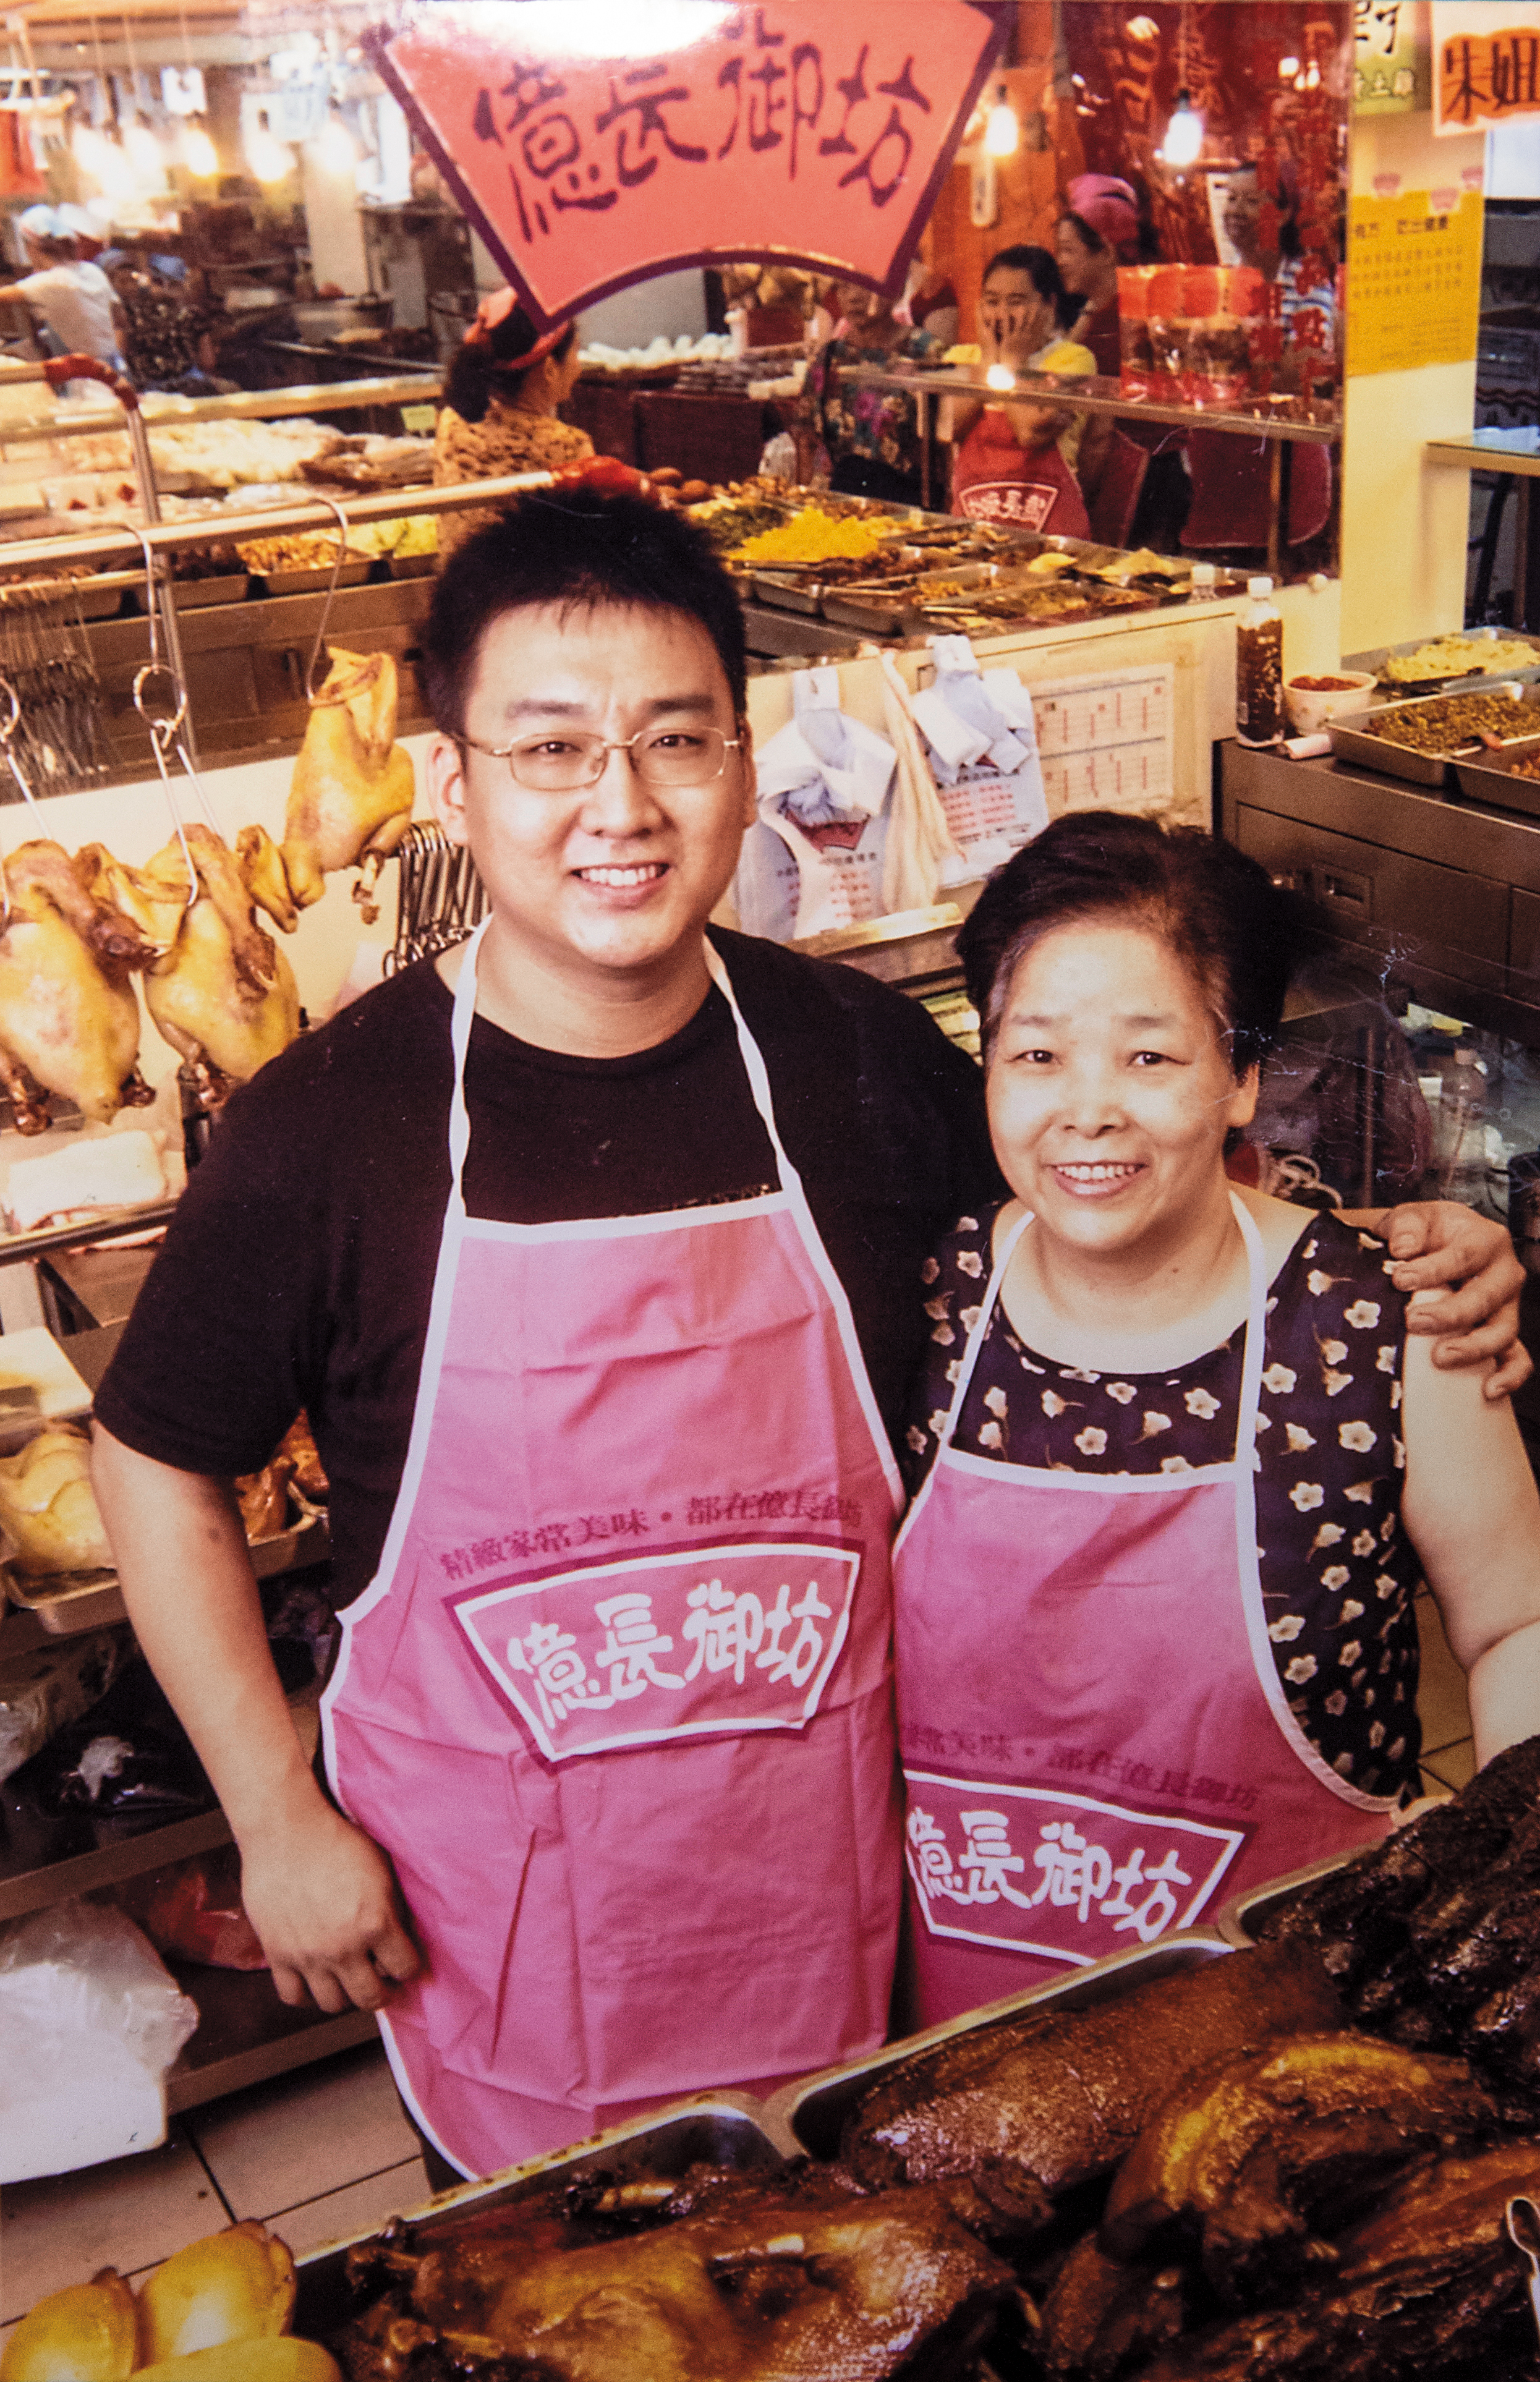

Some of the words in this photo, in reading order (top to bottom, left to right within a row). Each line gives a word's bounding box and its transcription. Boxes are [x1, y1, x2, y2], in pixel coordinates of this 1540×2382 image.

[507, 1579, 832, 1729] 億長御坊
[906, 1806, 1193, 1943] 億長御坊
